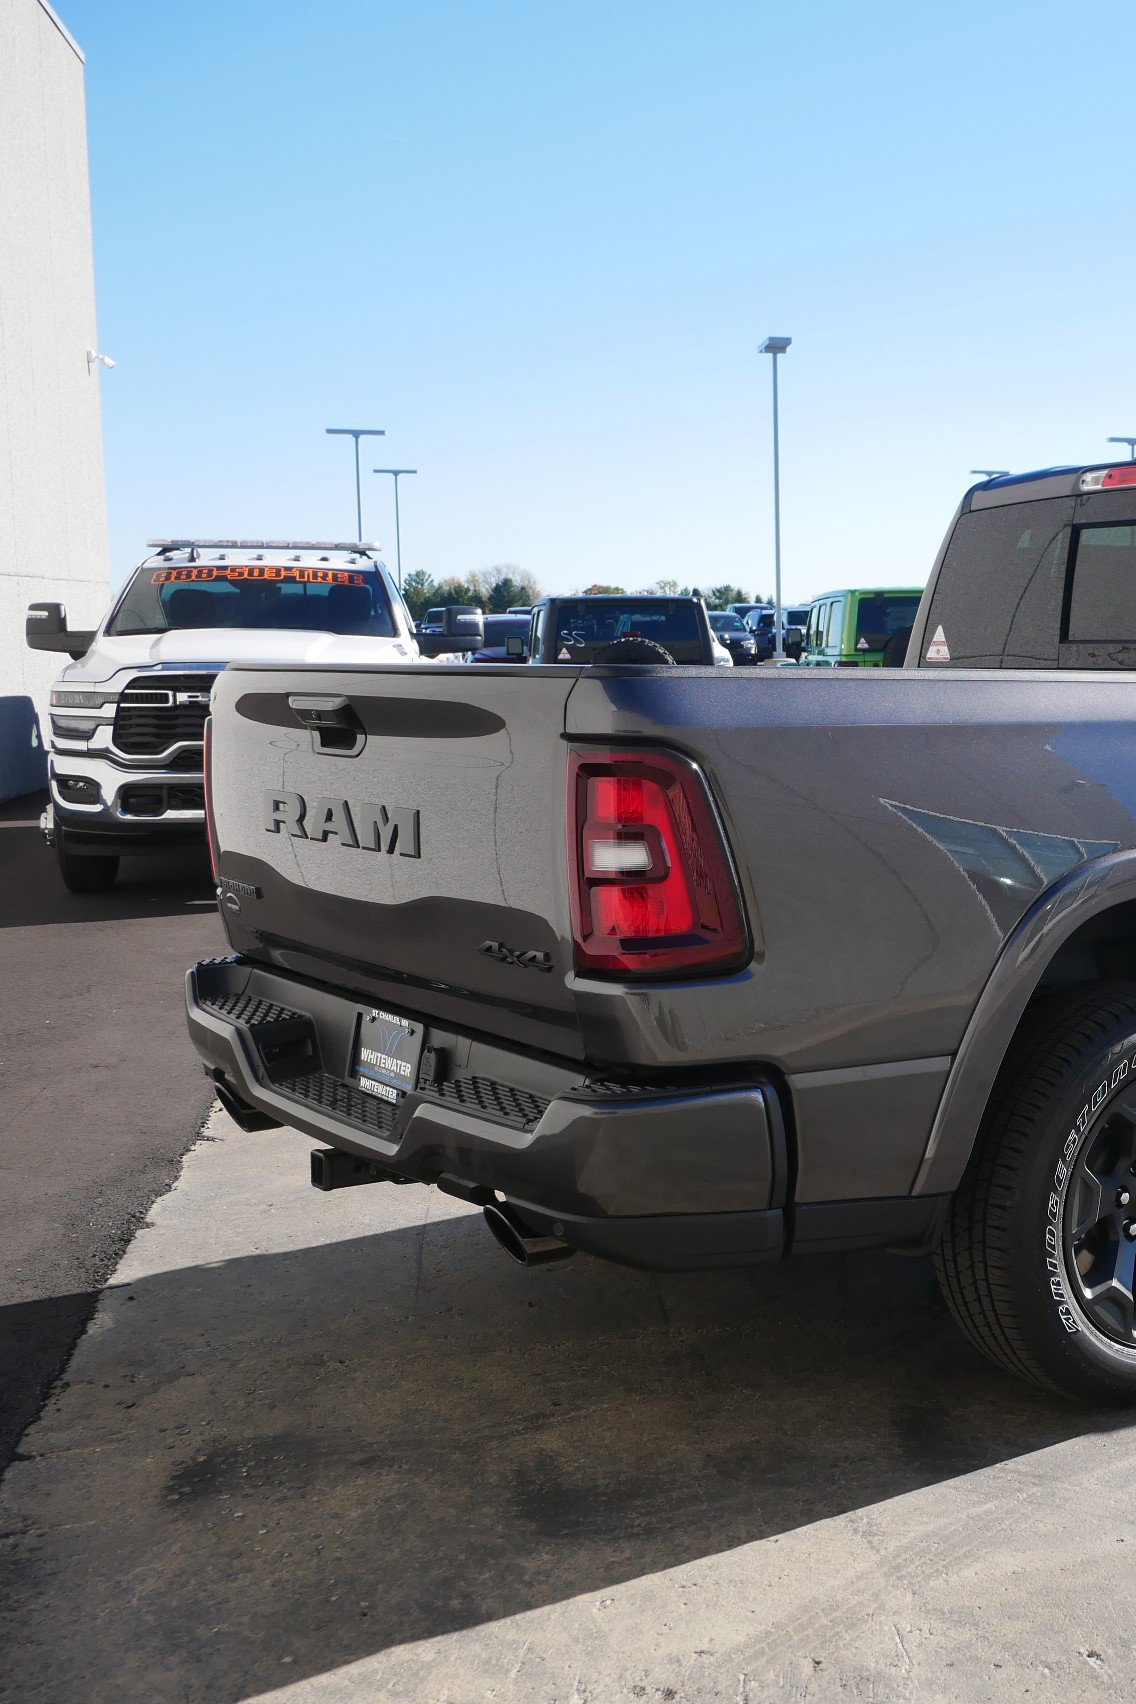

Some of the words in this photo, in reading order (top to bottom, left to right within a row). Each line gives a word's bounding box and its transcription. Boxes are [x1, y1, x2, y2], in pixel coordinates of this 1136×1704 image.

[151, 566, 365, 587] 888-503-TREE
[262, 788, 422, 860] RAM
[361, 1047, 412, 1077] WHITEWATER
[359, 1076, 398, 1099] WHITEWATER
